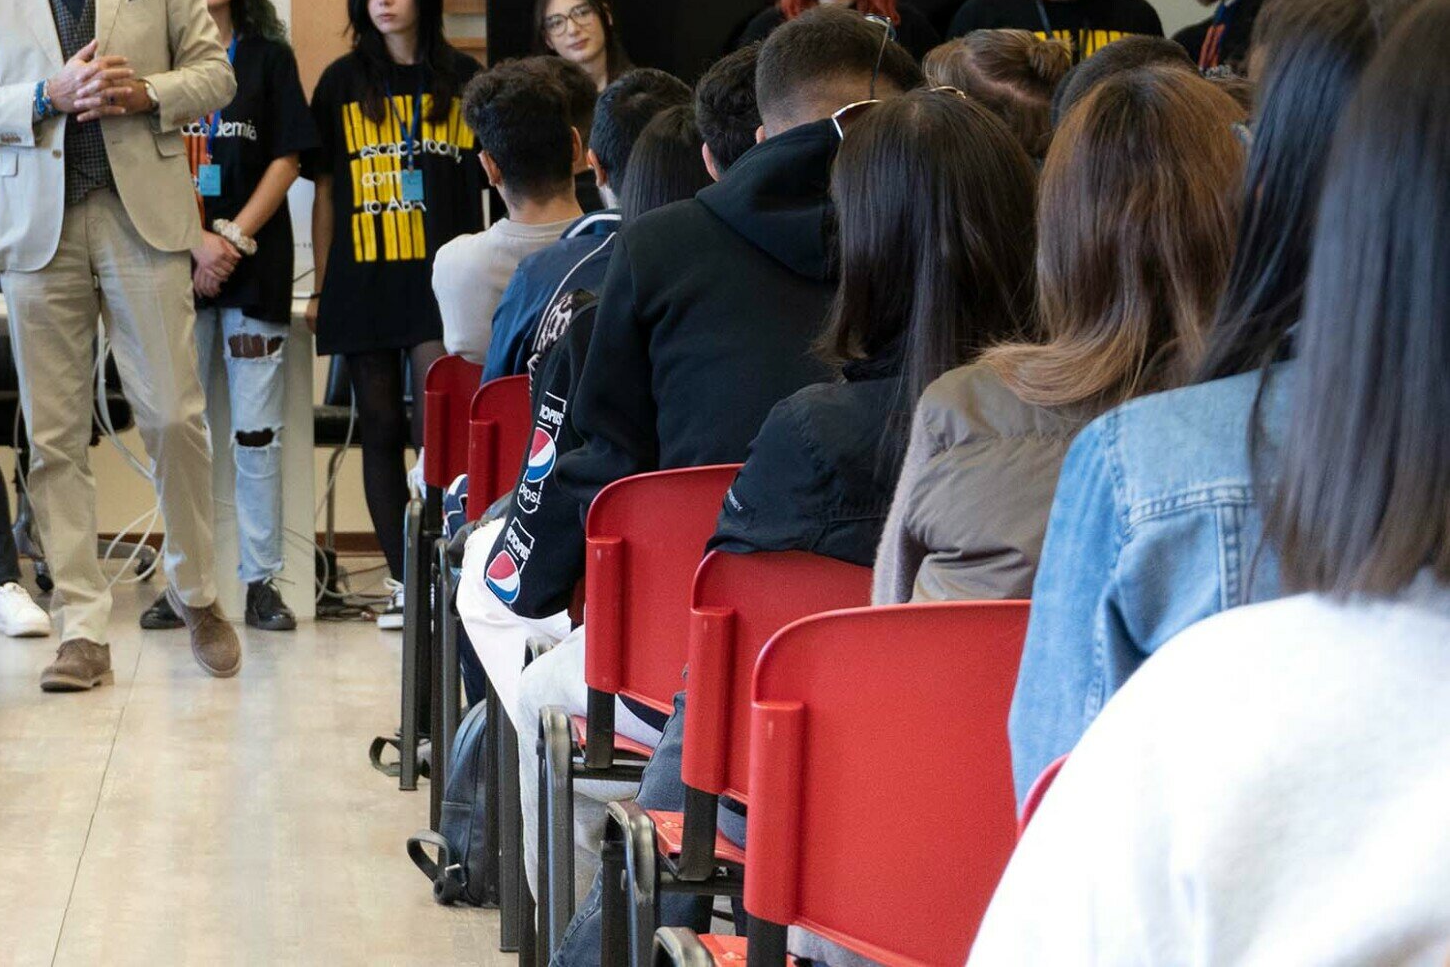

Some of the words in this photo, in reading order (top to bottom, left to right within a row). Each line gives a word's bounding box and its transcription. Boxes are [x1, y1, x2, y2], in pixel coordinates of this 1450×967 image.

[360, 140, 421, 159] escape
[361, 170, 402, 187] com
[363, 200, 382, 214] to
